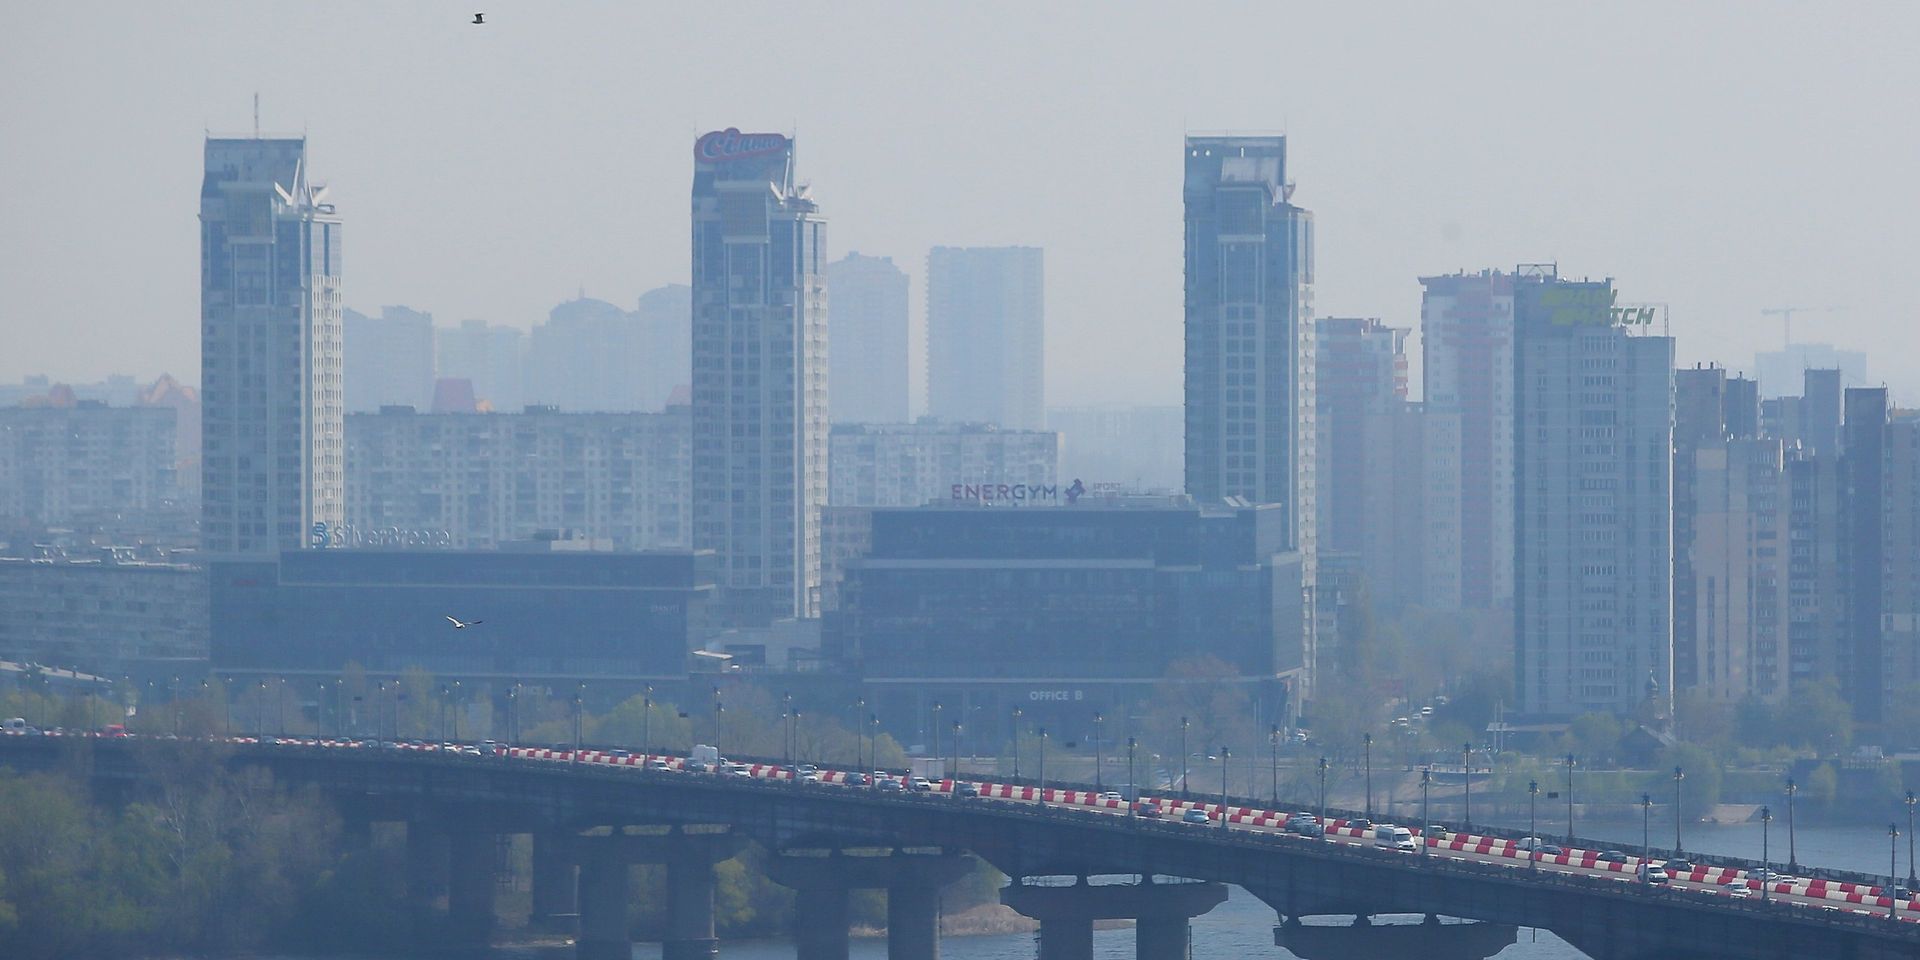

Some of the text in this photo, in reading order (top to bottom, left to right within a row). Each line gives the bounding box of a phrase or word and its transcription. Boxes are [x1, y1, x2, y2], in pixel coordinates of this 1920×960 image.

[951, 483, 1057, 501] ENERGYM
[1030, 690, 1083, 701] OFFICE B
